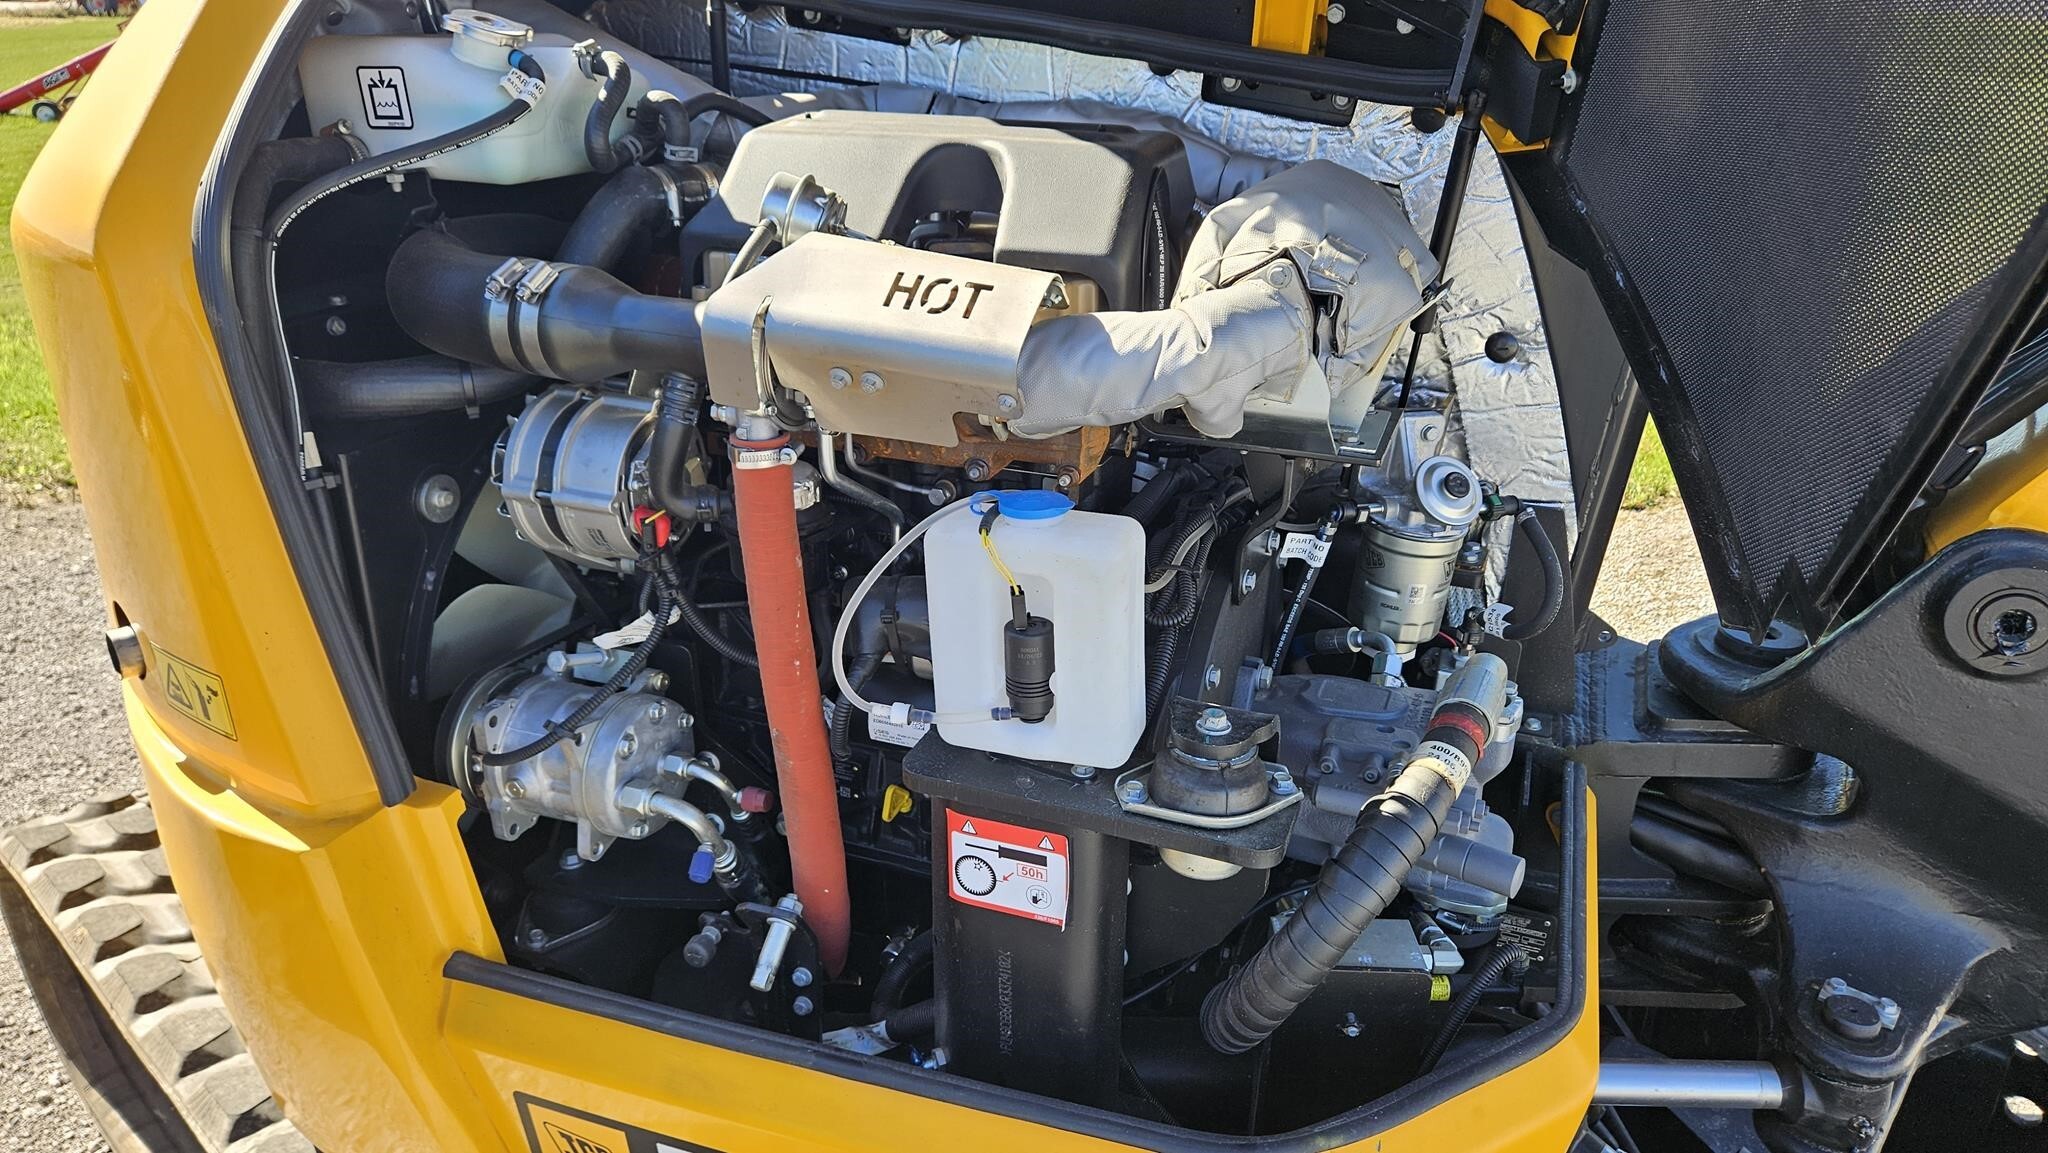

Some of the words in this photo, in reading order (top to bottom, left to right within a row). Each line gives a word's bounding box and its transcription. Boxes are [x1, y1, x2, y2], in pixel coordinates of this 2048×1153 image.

[532, 82, 544, 95] NO
[883, 272, 994, 319] HOT
[1290, 537, 1313, 545] PART
[1312, 542, 1325, 552] NO
[1286, 547, 1308, 555] BATCH
[1308, 551, 1322, 562] CODE
[1366, 550, 1383, 567] JCB
[1021, 867, 1043, 880] 50h
